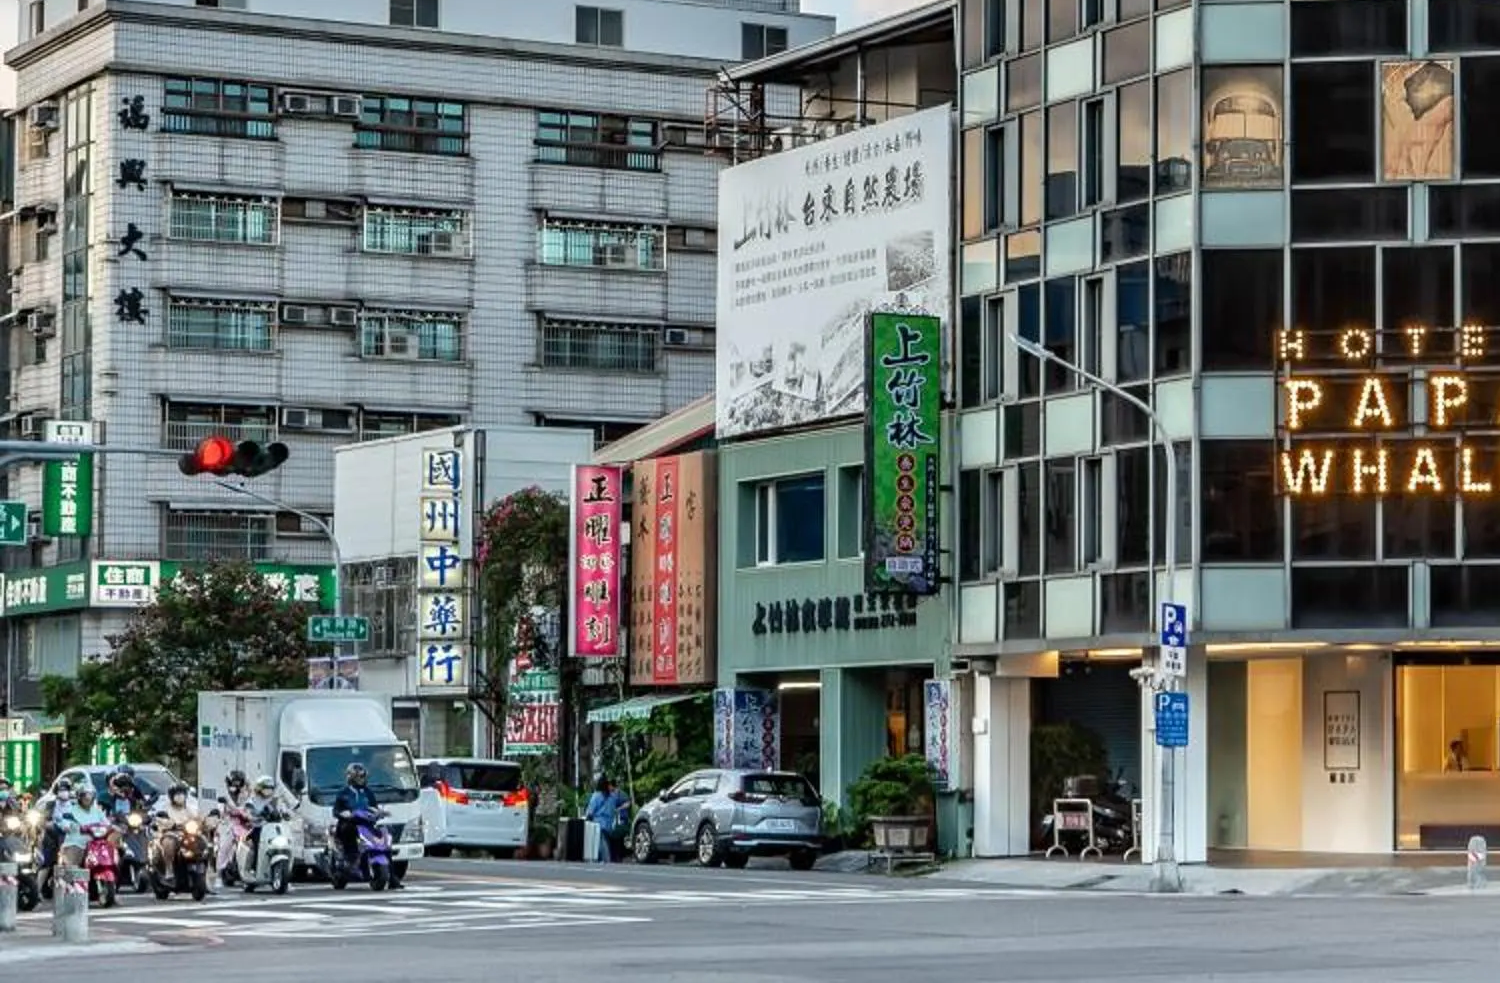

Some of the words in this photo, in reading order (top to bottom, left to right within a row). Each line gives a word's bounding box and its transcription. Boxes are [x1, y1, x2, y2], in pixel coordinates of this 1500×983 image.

[882, 323, 936, 451] 上竹林
[61, 455, 78, 534] 商不動產
[103, 568, 145, 584] 住商
[423, 450, 462, 684] 國州中藥行
